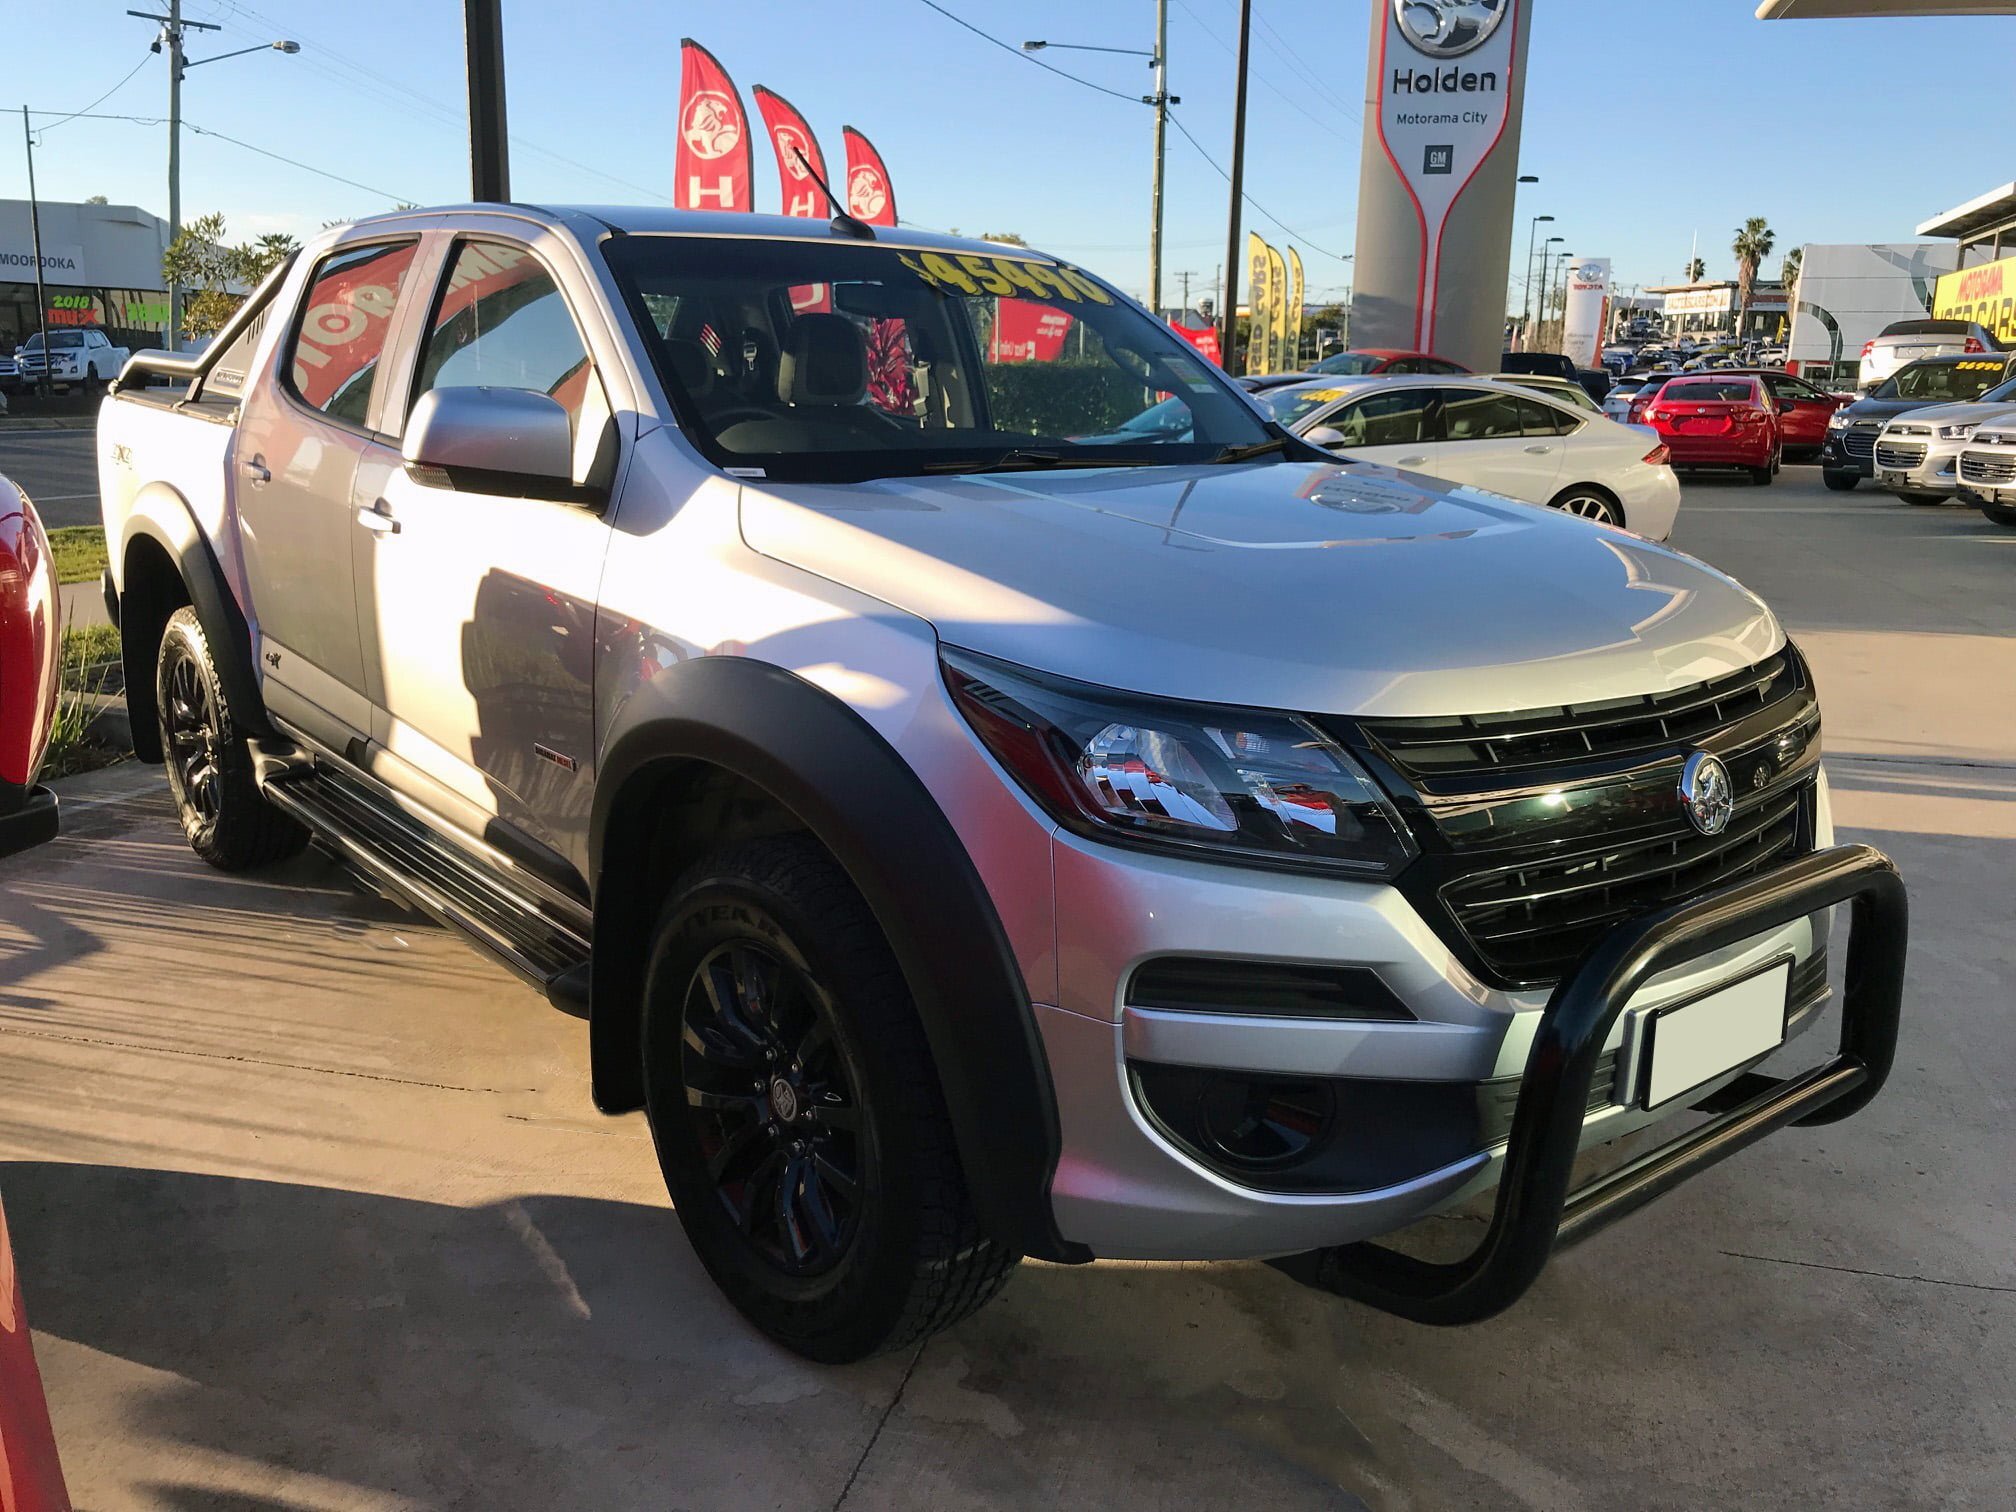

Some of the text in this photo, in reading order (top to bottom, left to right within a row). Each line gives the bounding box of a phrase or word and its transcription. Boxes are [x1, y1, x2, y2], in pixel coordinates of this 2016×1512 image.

[1393, 66, 1496, 94] Holden
[1397, 111, 1488, 126] Motorama City
[1429, 151, 1447, 164] GM
[0, 253, 77, 270] MOOROOKA
[53, 295, 90, 309] 2018
